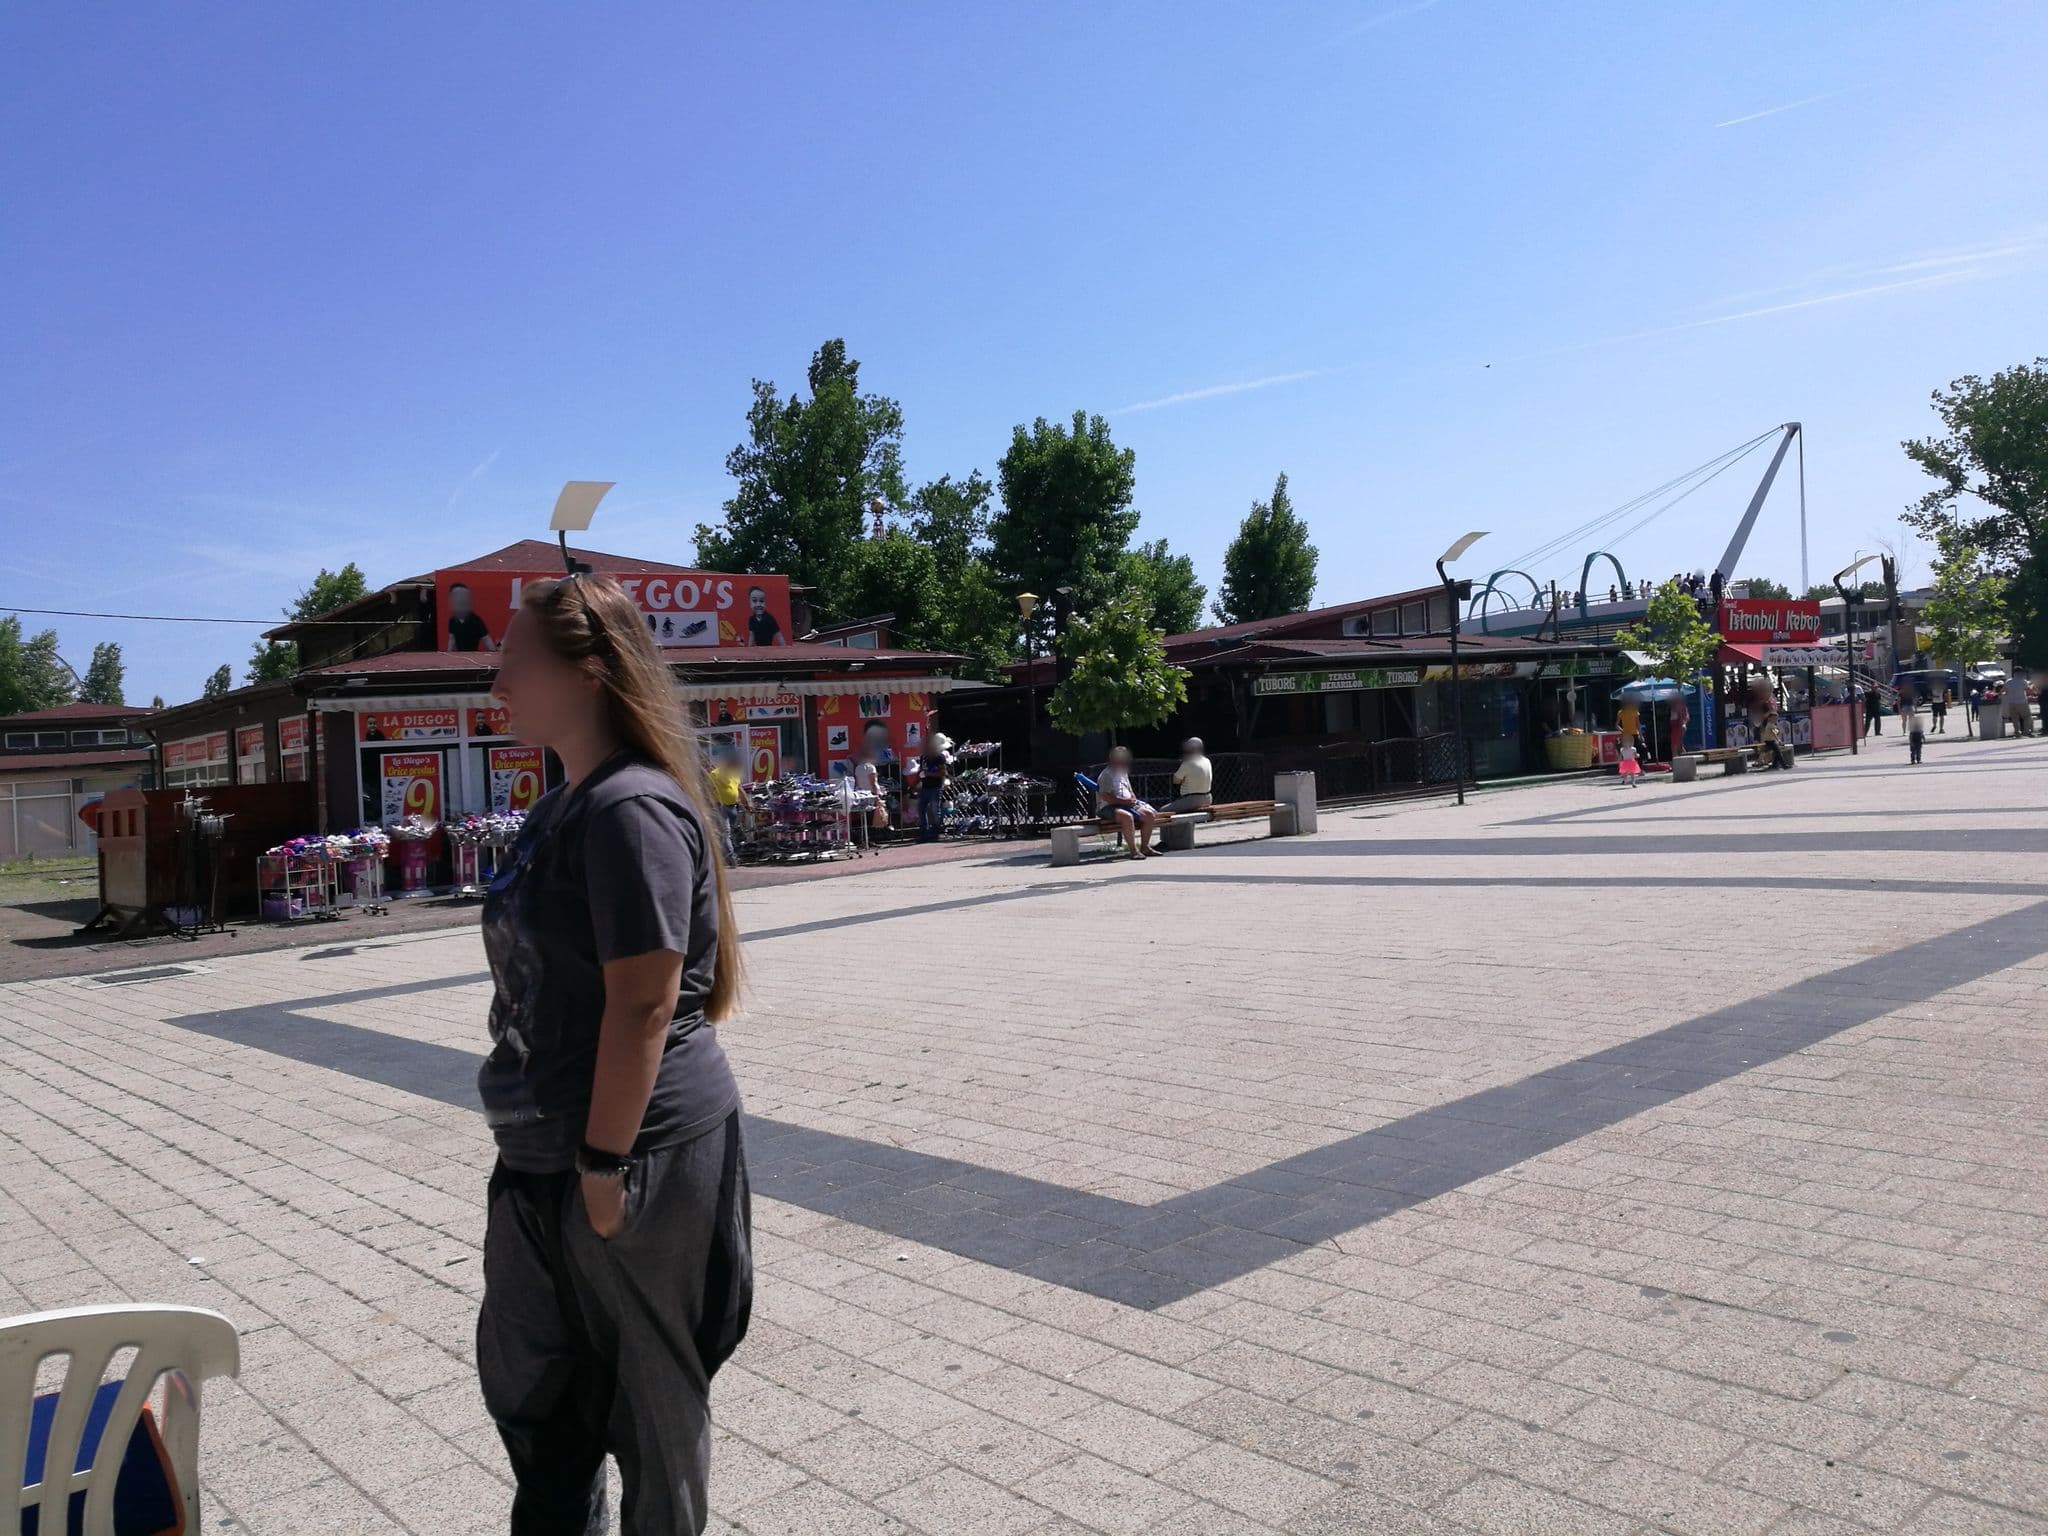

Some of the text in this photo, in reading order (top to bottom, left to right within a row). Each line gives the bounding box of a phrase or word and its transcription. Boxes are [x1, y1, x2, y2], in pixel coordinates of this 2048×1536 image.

[621, 579, 733, 610] EGO'S
[1729, 609, 1820, 634] Istanbul Kebap
[1328, 672, 1356, 681] TERASA
[1386, 670, 1418, 684] TUBORG
[1259, 676, 1296, 692] TUBORG
[755, 694, 800, 705] DIEGO'S
[383, 714, 456, 727] LA DIEGO'S
[490, 711, 506, 722] LA
[499, 750, 535, 760] La Diego's
[391, 757, 431, 767] La Diego's
[495, 759, 540, 770] Orice produs
[754, 748, 775, 783] 9
[387, 766, 436, 777] Orice produs
[406, 778, 435, 817] 9
[512, 771, 540, 811] 9
